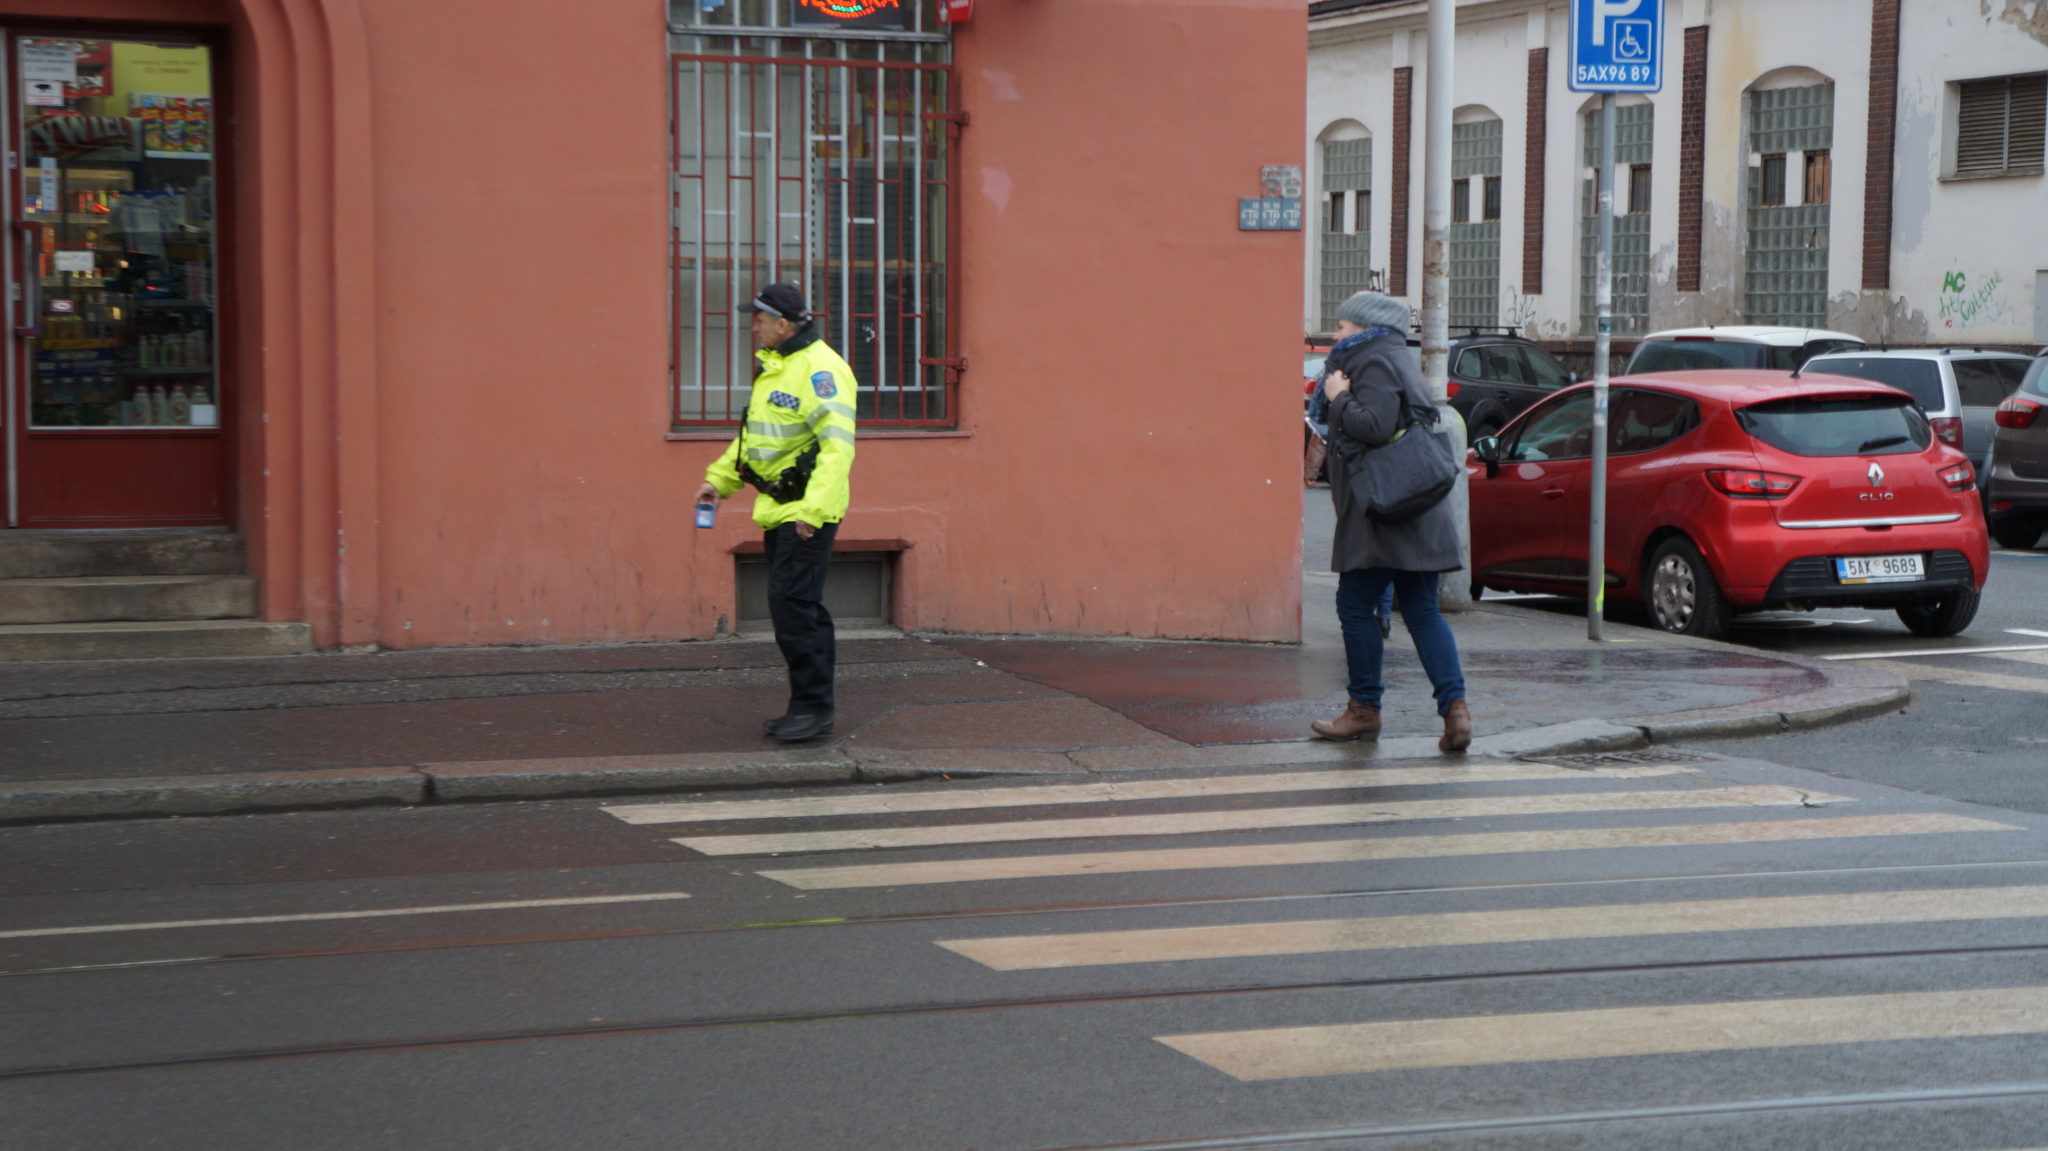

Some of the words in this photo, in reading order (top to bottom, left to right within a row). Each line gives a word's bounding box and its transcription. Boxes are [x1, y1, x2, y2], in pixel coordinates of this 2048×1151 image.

[1578, 65, 1627, 82] 5AX96
[1631, 65, 1650, 82] 89
[1859, 492, 1894, 501] CLIO
[1847, 559, 1872, 576] 5AX
[1882, 558, 1917, 574] 9689
